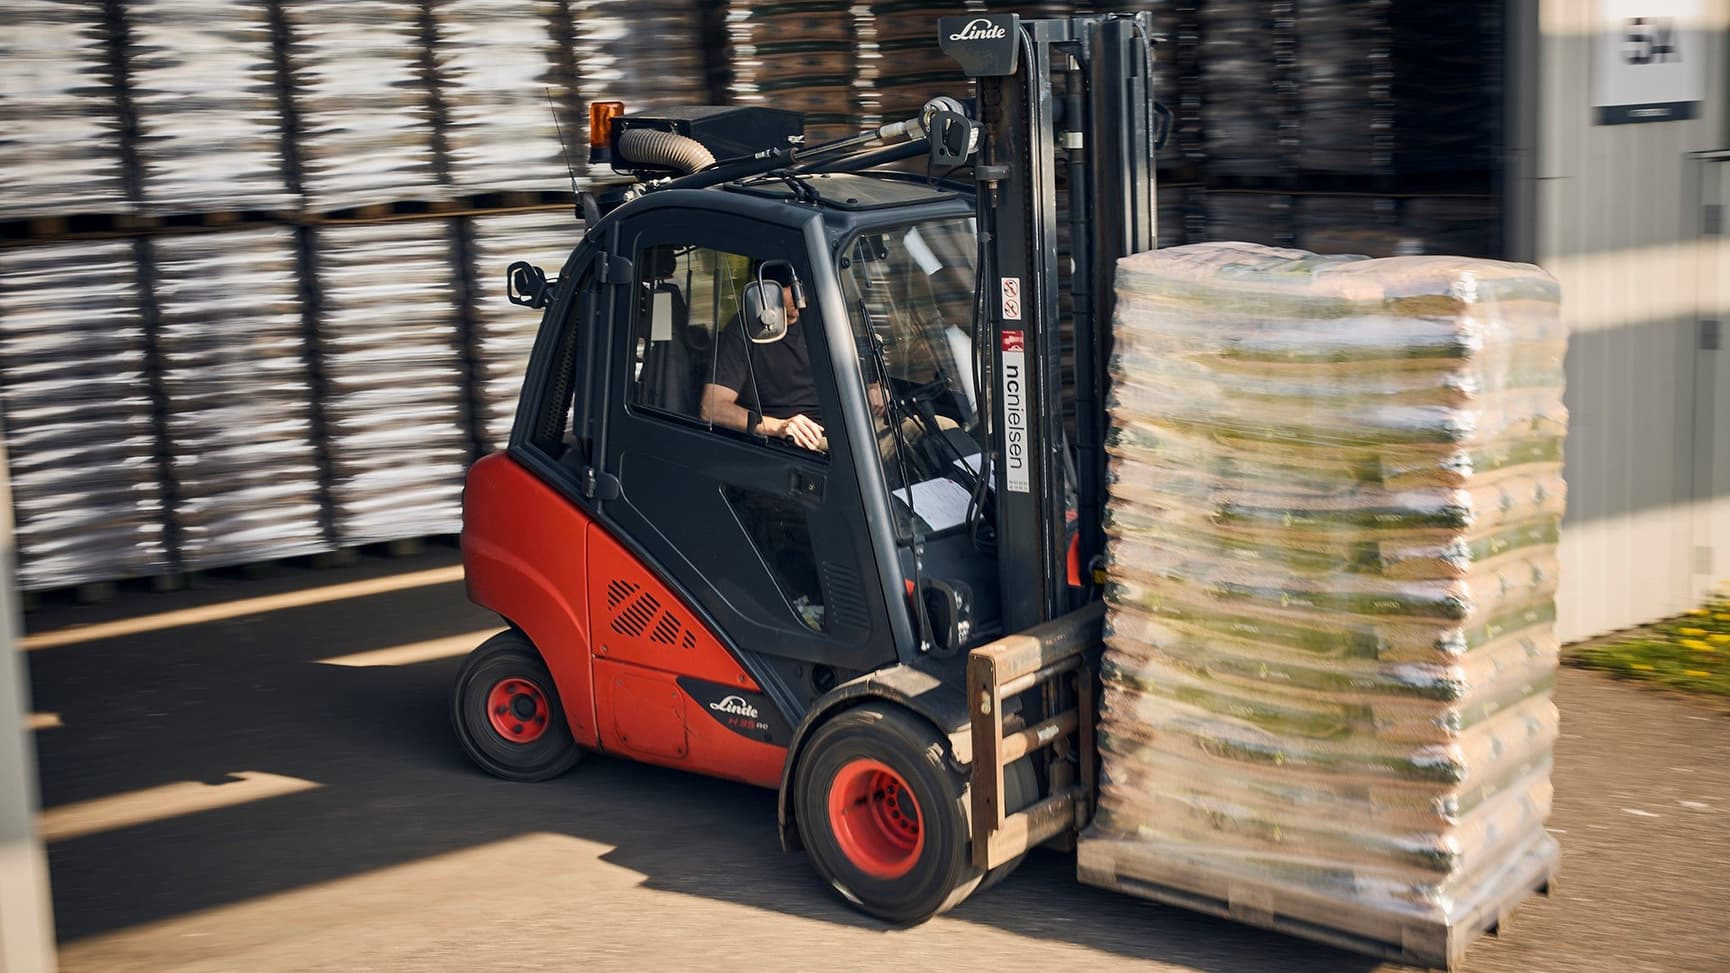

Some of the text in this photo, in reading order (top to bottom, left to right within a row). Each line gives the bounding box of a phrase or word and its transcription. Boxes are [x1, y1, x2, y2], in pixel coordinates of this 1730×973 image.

[949, 18, 1006, 40] Linde
[1006, 364, 1025, 469] ncnielsen
[709, 695, 759, 718] Linde
